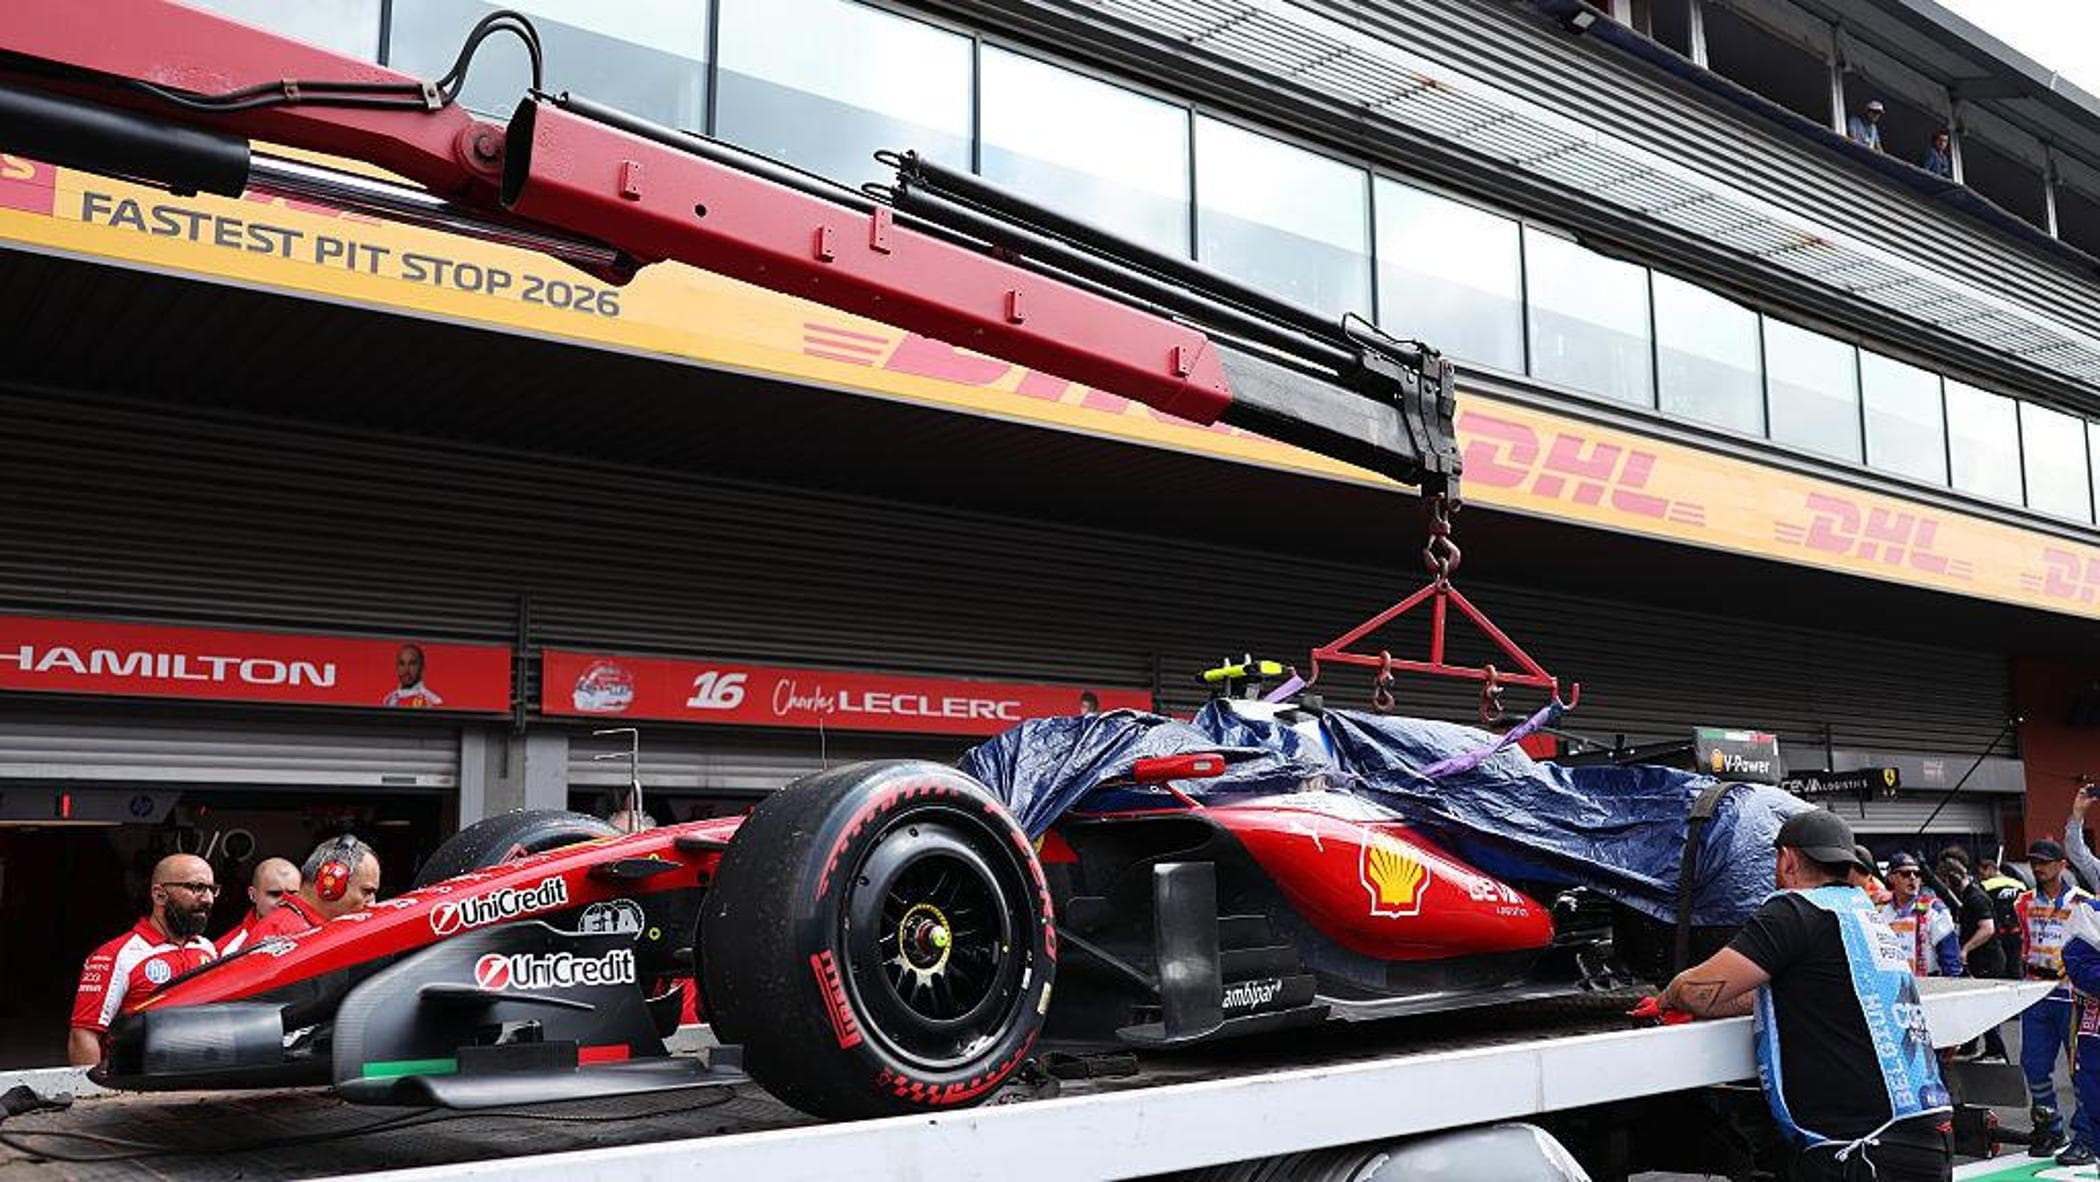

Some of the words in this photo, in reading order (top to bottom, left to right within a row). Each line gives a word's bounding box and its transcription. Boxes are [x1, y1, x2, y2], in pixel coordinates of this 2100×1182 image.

[81, 191, 304, 258] FASTEST
[315, 233, 390, 276] PIT
[401, 252, 513, 296] STOP
[522, 274, 621, 317] 2026
[1457, 411, 1670, 518] DHL
[1804, 492, 1949, 574] DHL
[687, 671, 747, 709] 16
[773, 678, 834, 716] Charles
[840, 690, 1022, 720] LECLERC
[1724, 754, 1770, 774] V-Power
[459, 876, 567, 927] UniCredit
[511, 949, 635, 989] UniCredit
[1221, 979, 1280, 1010] ambipar
